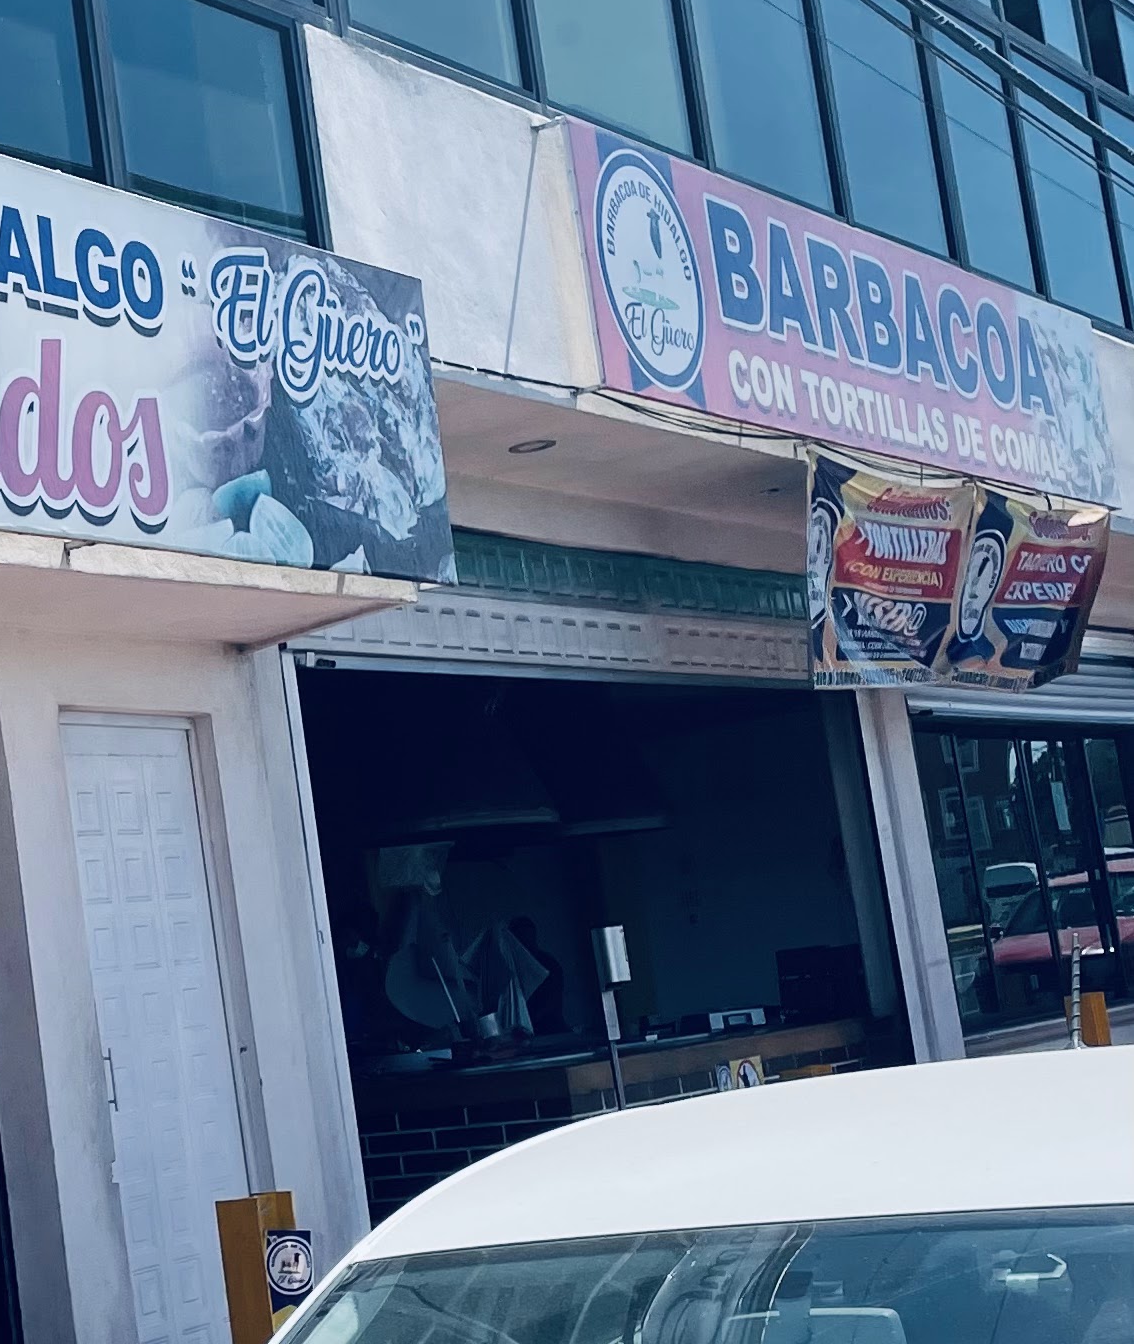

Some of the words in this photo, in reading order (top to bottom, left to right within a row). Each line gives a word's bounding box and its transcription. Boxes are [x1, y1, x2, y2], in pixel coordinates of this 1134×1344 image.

[607, 179, 638, 257] BARBACOA
[637, 180, 652, 205] DE
[653, 193, 693, 282] HIDALGO
[624, 301, 647, 341] El
[650, 307, 695, 357] Güero
[705, 195, 1055, 417] BARBACOA
[728, 349, 797, 415] CON
[800, 369, 949, 454] TORTILLAS
[952, 413, 987, 462] DE
[990, 423, 1065, 482] COMAL
